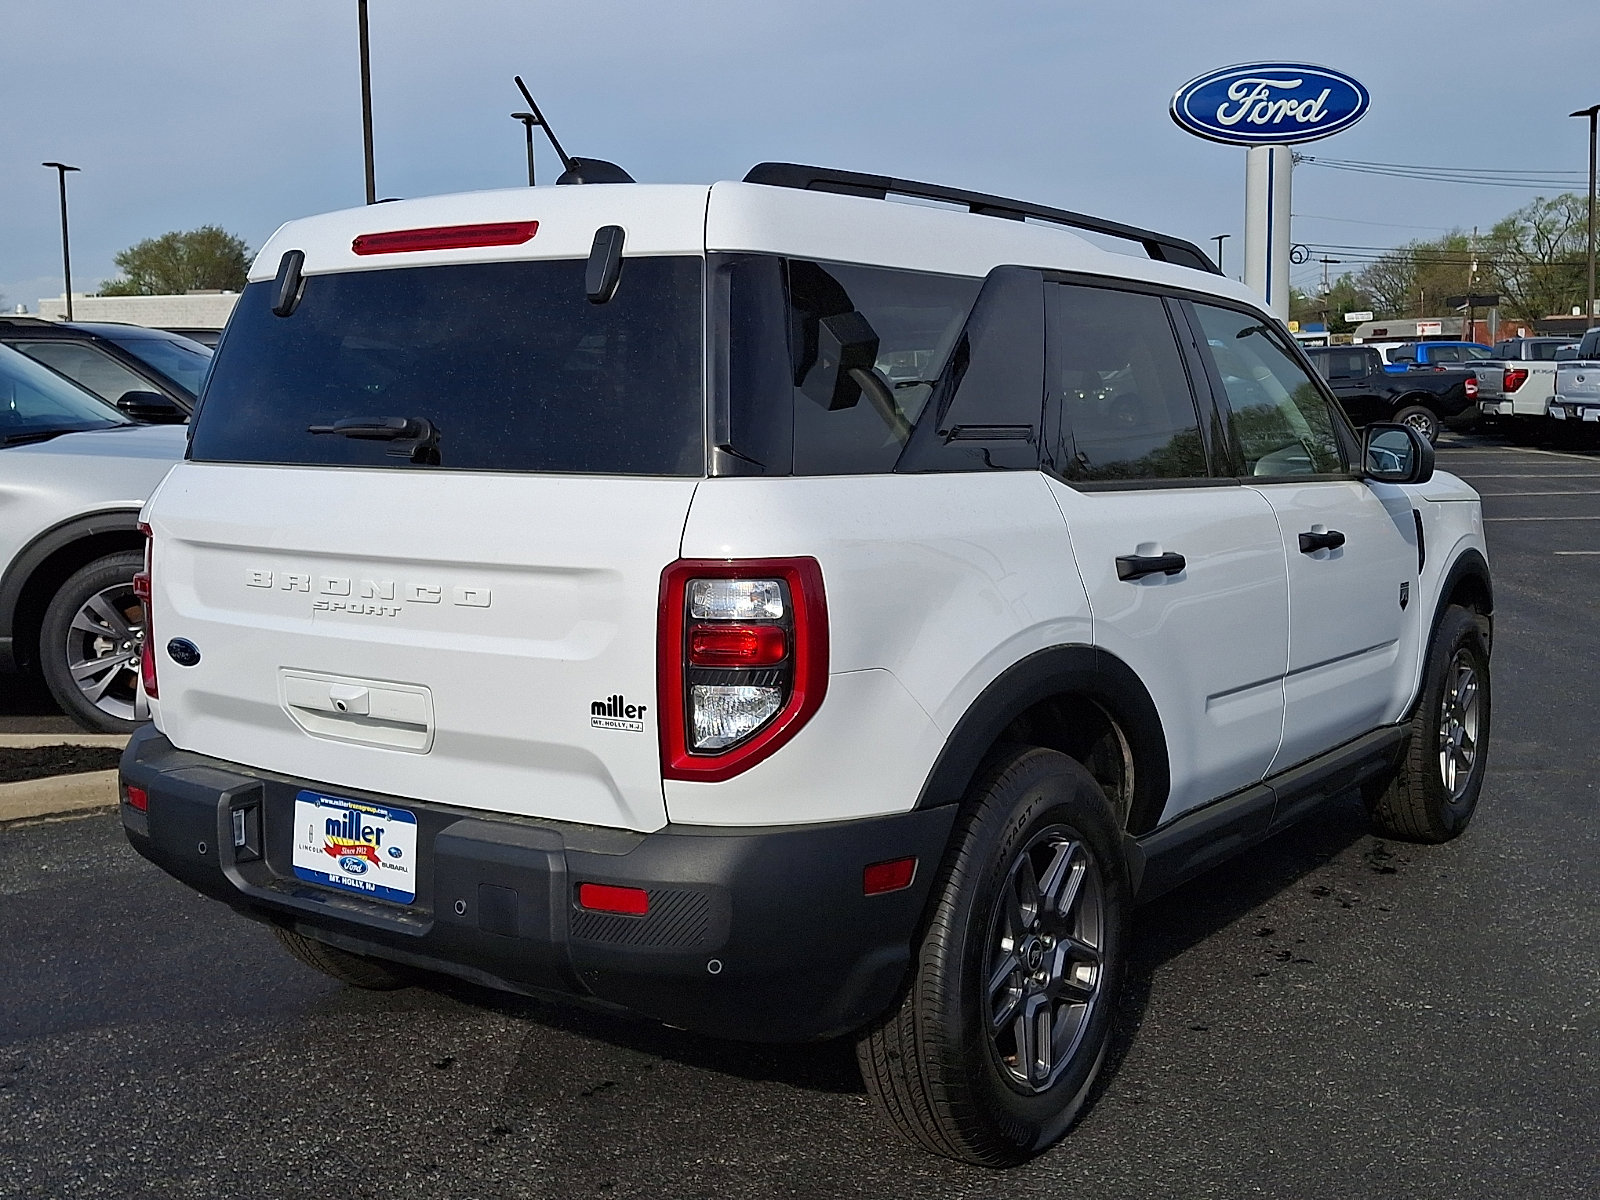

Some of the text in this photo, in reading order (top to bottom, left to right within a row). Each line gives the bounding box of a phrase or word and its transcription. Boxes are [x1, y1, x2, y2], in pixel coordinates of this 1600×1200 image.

[1216, 78, 1331, 126] Ford
[245, 568, 492, 609] BRONCO
[312, 600, 402, 617] SPORT
[591, 694, 647, 720] miller
[325, 810, 385, 846] miller
[298, 843, 323, 854] LINCOLN
[341, 846, 355, 855] Since
[344, 858, 363, 873] Ford
[381, 862, 408, 873] SUBARU
[329, 874, 341, 883] MT.
[365, 881, 376, 892] NJ
